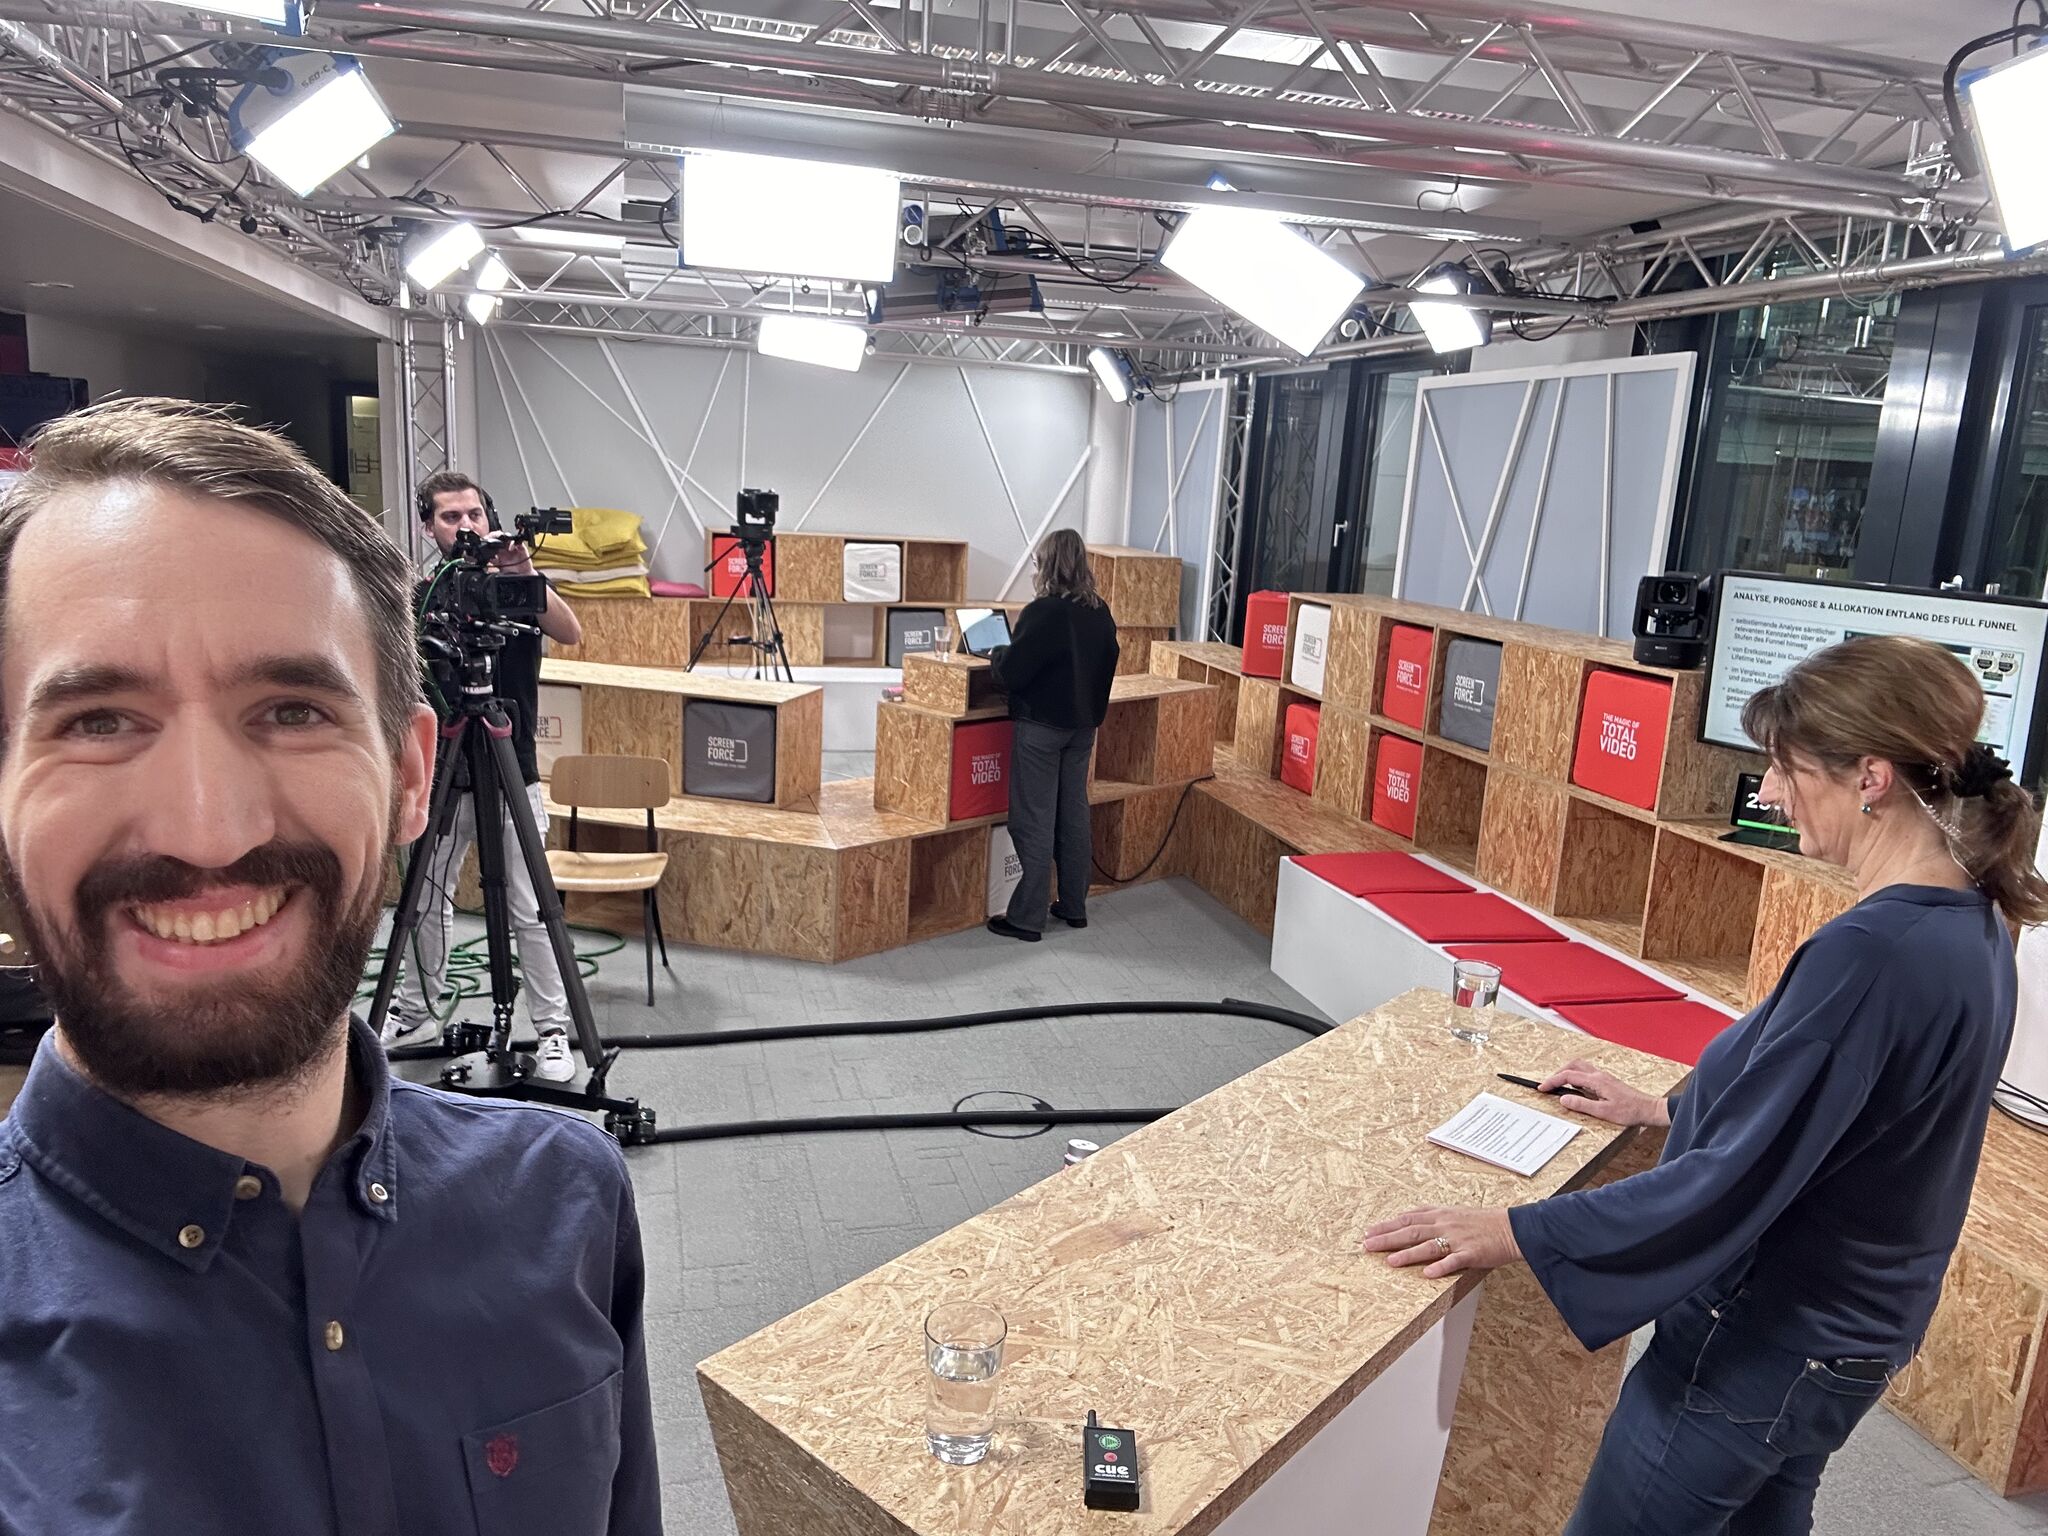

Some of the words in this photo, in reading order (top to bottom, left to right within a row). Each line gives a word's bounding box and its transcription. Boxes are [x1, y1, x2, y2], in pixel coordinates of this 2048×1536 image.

[1734, 592, 1772, 604] ANALYSE,
[1773, 597, 1818, 608] PROGNOSE
[1828, 603, 1884, 616] ALLOKATION
[1885, 609, 1929, 622] ENTLANG
[1931, 614, 1951, 624] DES
[1952, 617, 1976, 627] FULL
[1978, 619, 2018, 632] FUNNEL
[1263, 624, 1287, 634] SCREE
[1765, 629, 1800, 639] Kennzahlen
[1779, 623, 1802, 632] Analyse
[1262, 633, 1286, 645] FORC
[1734, 633, 1753, 641] Stufen
[1754, 635, 1765, 643] des
[1765, 636, 1785, 645] Funnel
[1396, 670, 1413, 687] FORCE
[1455, 674, 1475, 689] SCREEN
[1454, 686, 1474, 704] FORCE
[1603, 712, 1613, 722] THE
[1614, 715, 1632, 727] MAGIC
[1632, 720, 1640, 729] OF
[1602, 720, 1637, 745] TOTAL
[708, 736, 735, 749] SCREEN
[1600, 734, 1637, 760] VIDEO
[708, 747, 735, 761] FORCE
[972, 759, 1001, 773] TOTAL
[971, 770, 1001, 785] VIDEO
[1388, 774, 1409, 791] TOTAL
[1386, 785, 1410, 803] VIDEO
[1005, 863, 1022, 877] FORC
[1094, 1464, 1129, 1475] cue
